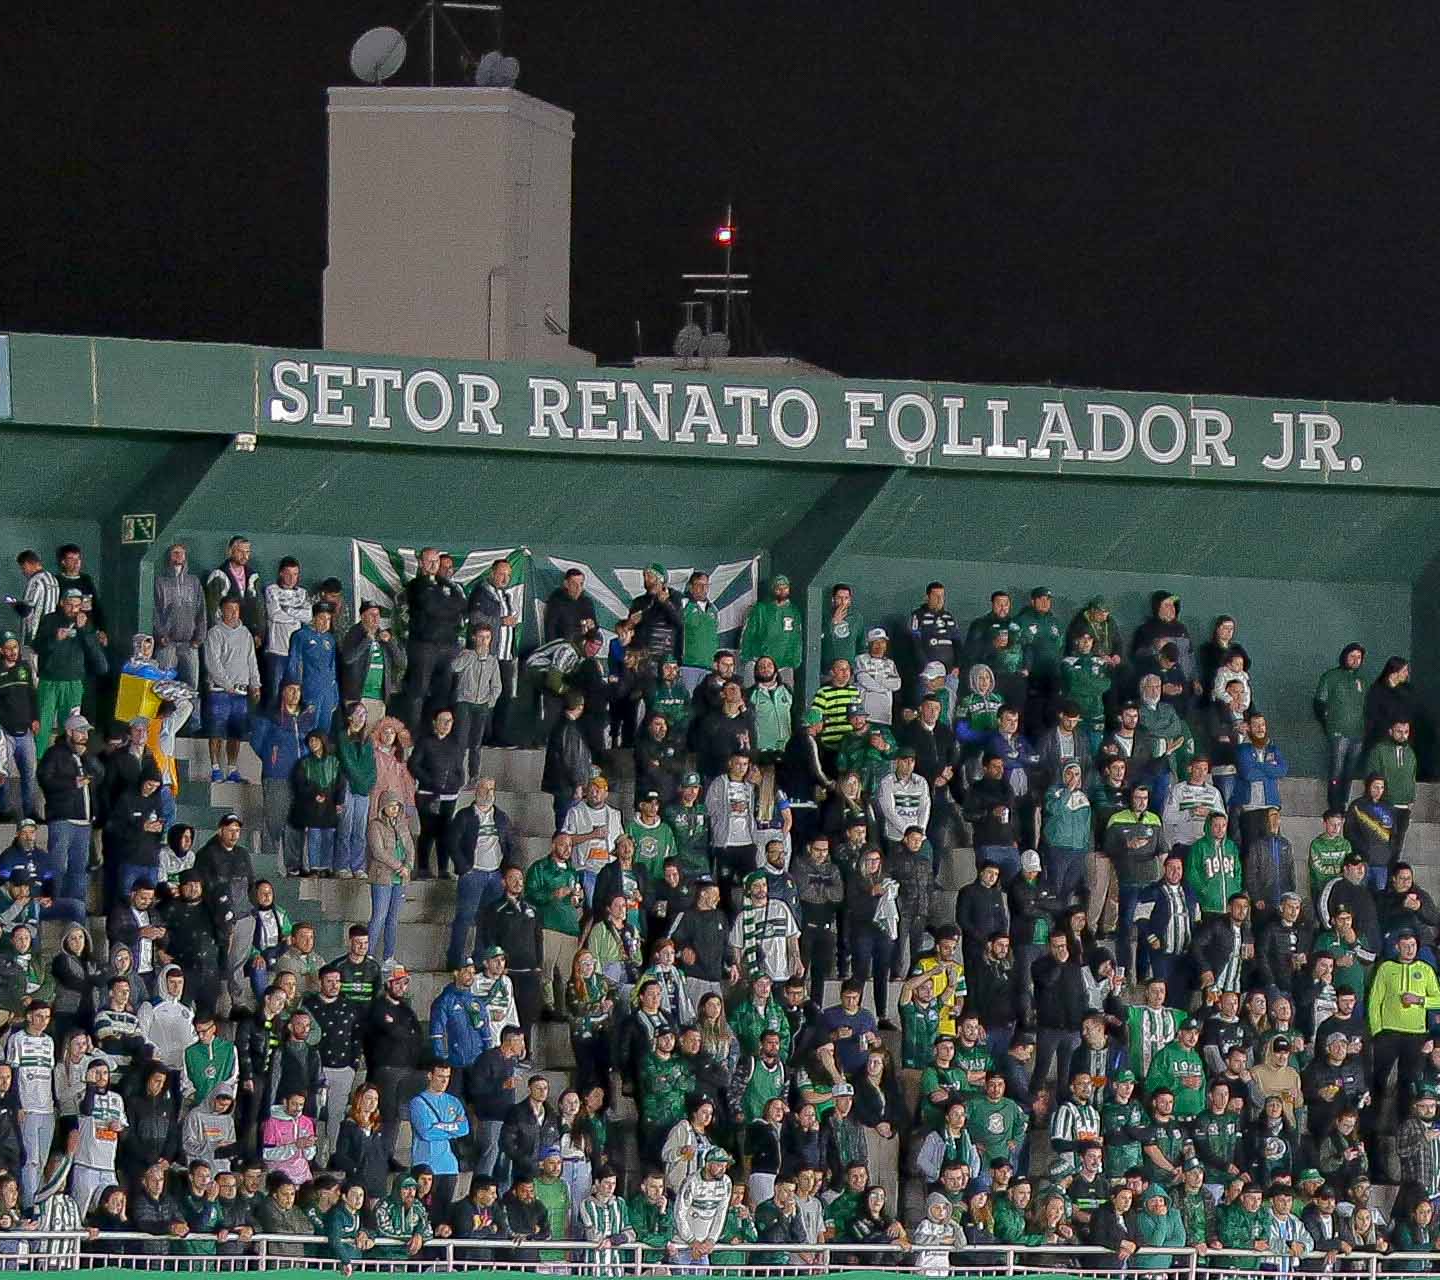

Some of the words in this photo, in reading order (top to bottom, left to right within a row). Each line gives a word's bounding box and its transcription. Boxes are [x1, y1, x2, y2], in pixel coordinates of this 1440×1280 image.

[270, 360, 500, 437] SETOR
[528, 376, 825, 450] RENATO
[843, 391, 1236, 469] FOLLADOR
[1263, 411, 1364, 473] JR.
